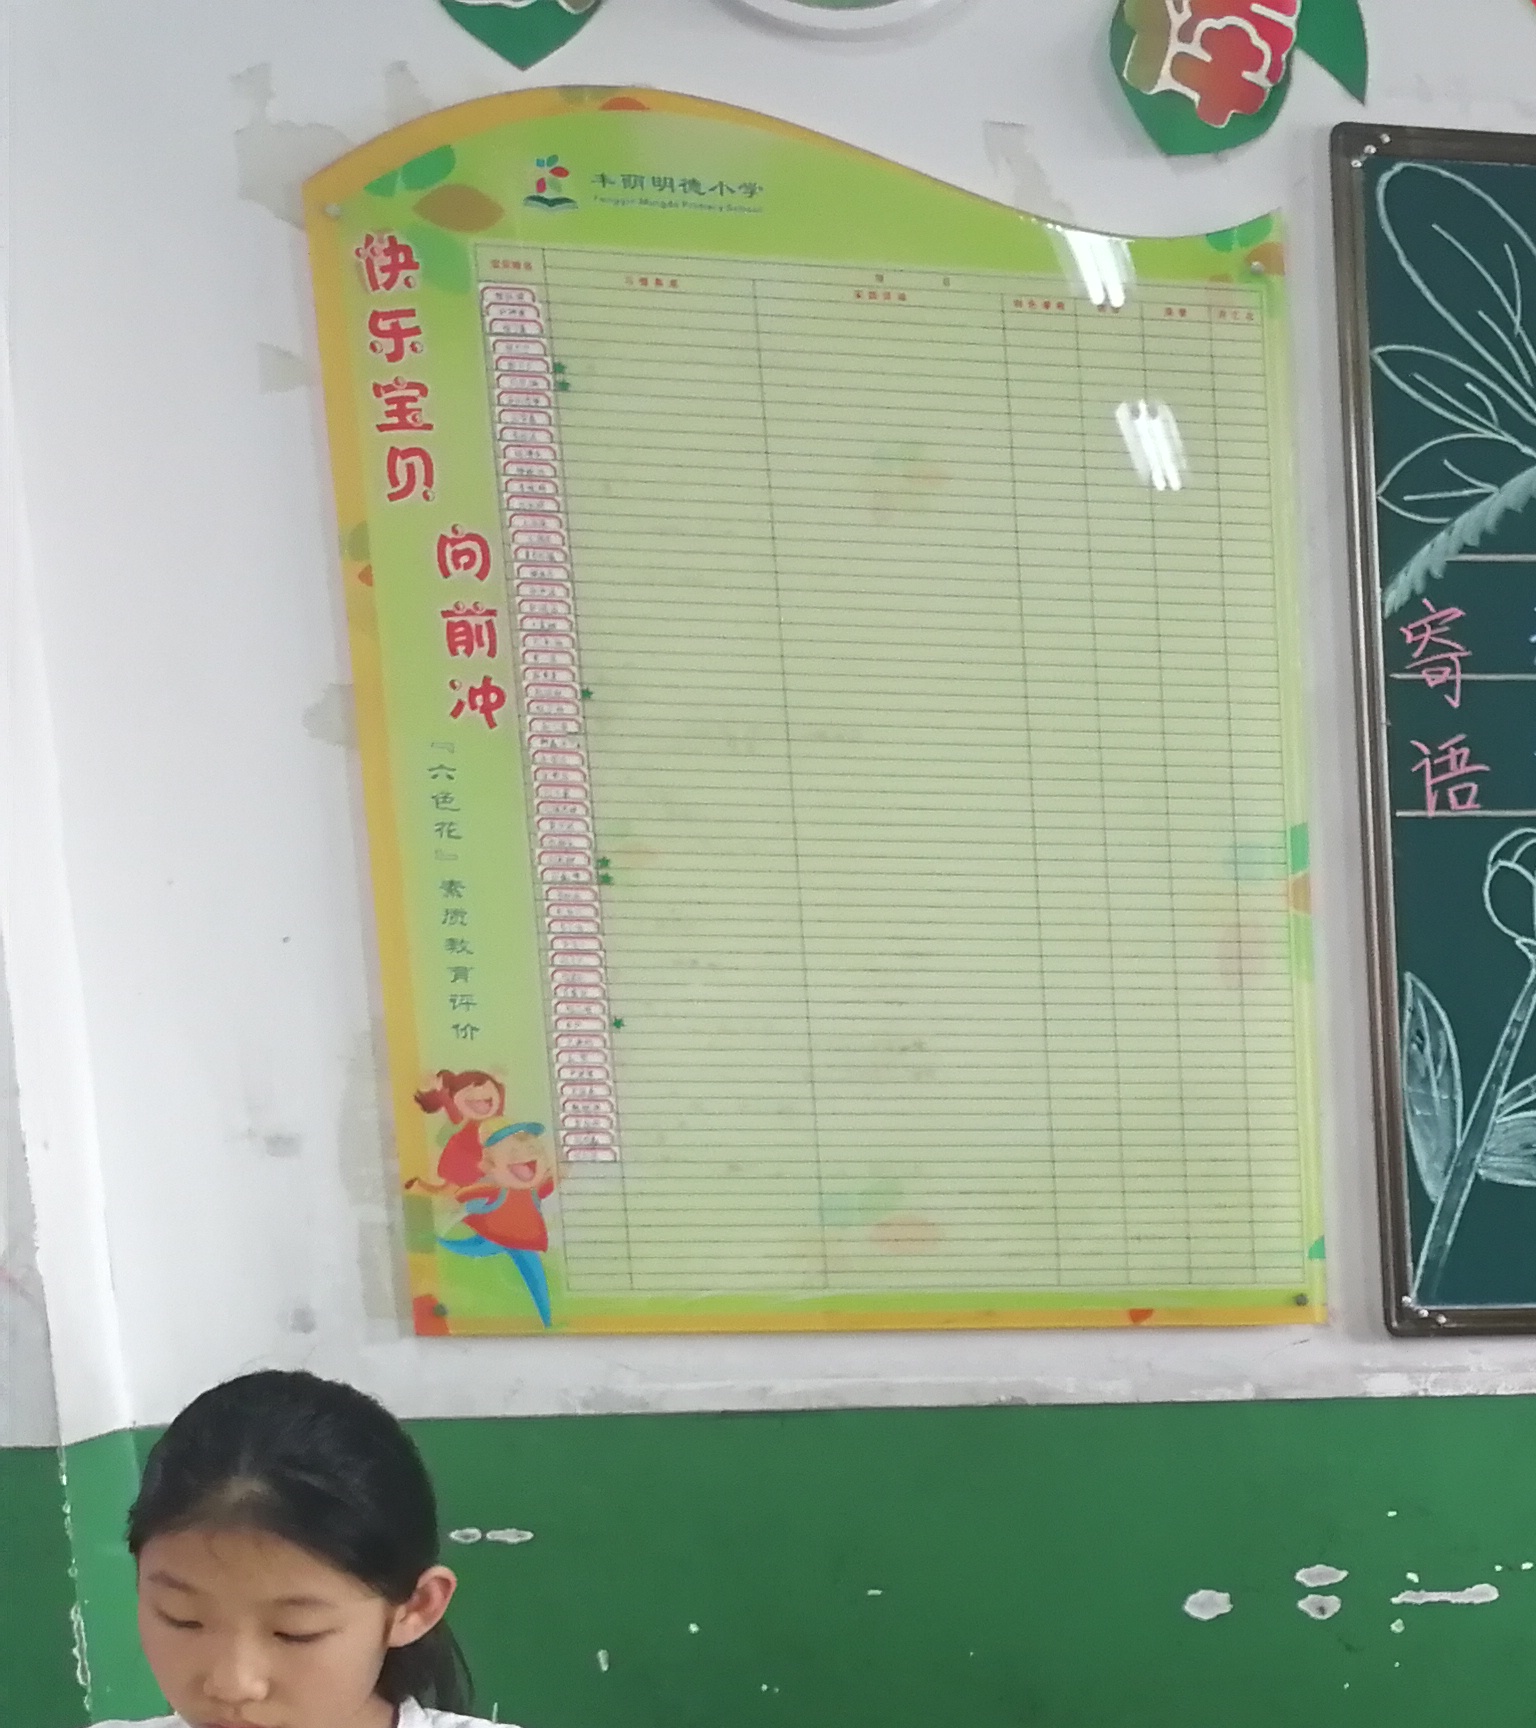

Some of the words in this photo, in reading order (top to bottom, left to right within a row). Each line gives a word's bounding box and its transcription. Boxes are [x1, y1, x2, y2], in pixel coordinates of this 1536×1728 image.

[355, 233, 435, 503] 快乐宝贝
[436, 523, 508, 730] 向前冲
[1400, 598, 1491, 818] 寄语
